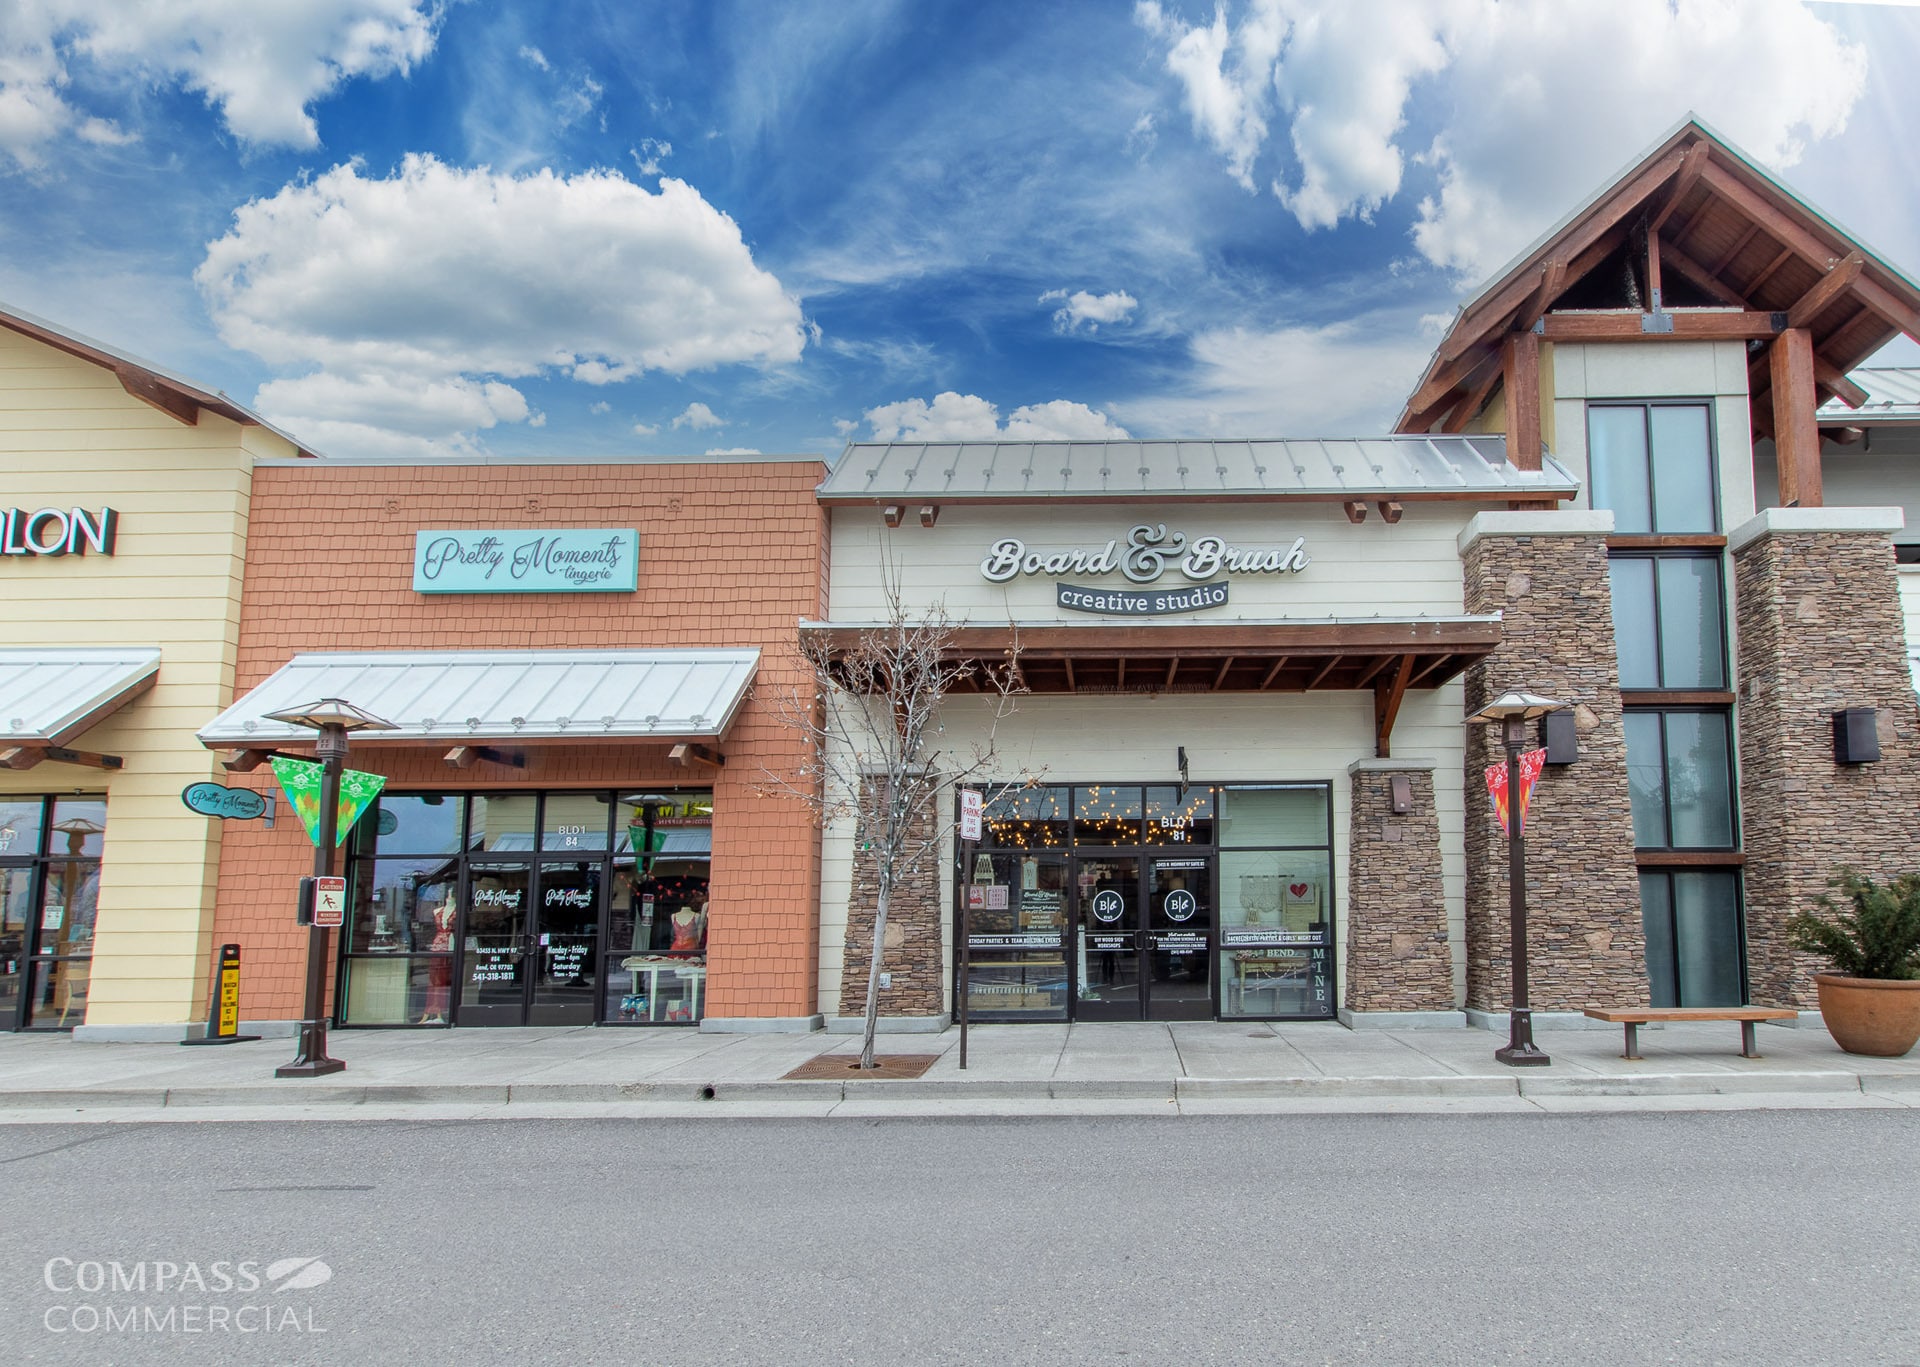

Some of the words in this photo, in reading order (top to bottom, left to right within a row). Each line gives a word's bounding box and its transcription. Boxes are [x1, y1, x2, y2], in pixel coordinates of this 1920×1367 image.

[0, 507, 119, 557] LON
[423, 536, 504, 580] Pretty
[510, 535, 627, 579] Moments
[980, 538, 1119, 583] Board
[1120, 523, 1187, 584] &
[1181, 536, 1312, 583] Brush
[1060, 589, 1148, 612] creative
[1156, 586, 1226, 611] studio
[191, 789, 222, 808] Pretty
[223, 794, 261, 811] Moments
[968, 796, 976, 807] NO
[963, 807, 980, 818] PARKING
[1161, 817, 1185, 828] BLD
[1173, 830, 1185, 841] 81
[565, 836, 578, 847] 84
[547, 945, 568, 955] Monday
[572, 945, 588, 956] Friday
[1267, 949, 1295, 957] BEND
[553, 963, 581, 971] Saturday
[472, 972, 514, 981] 541-318-1811
[1313, 948, 1325, 1001] MINE
